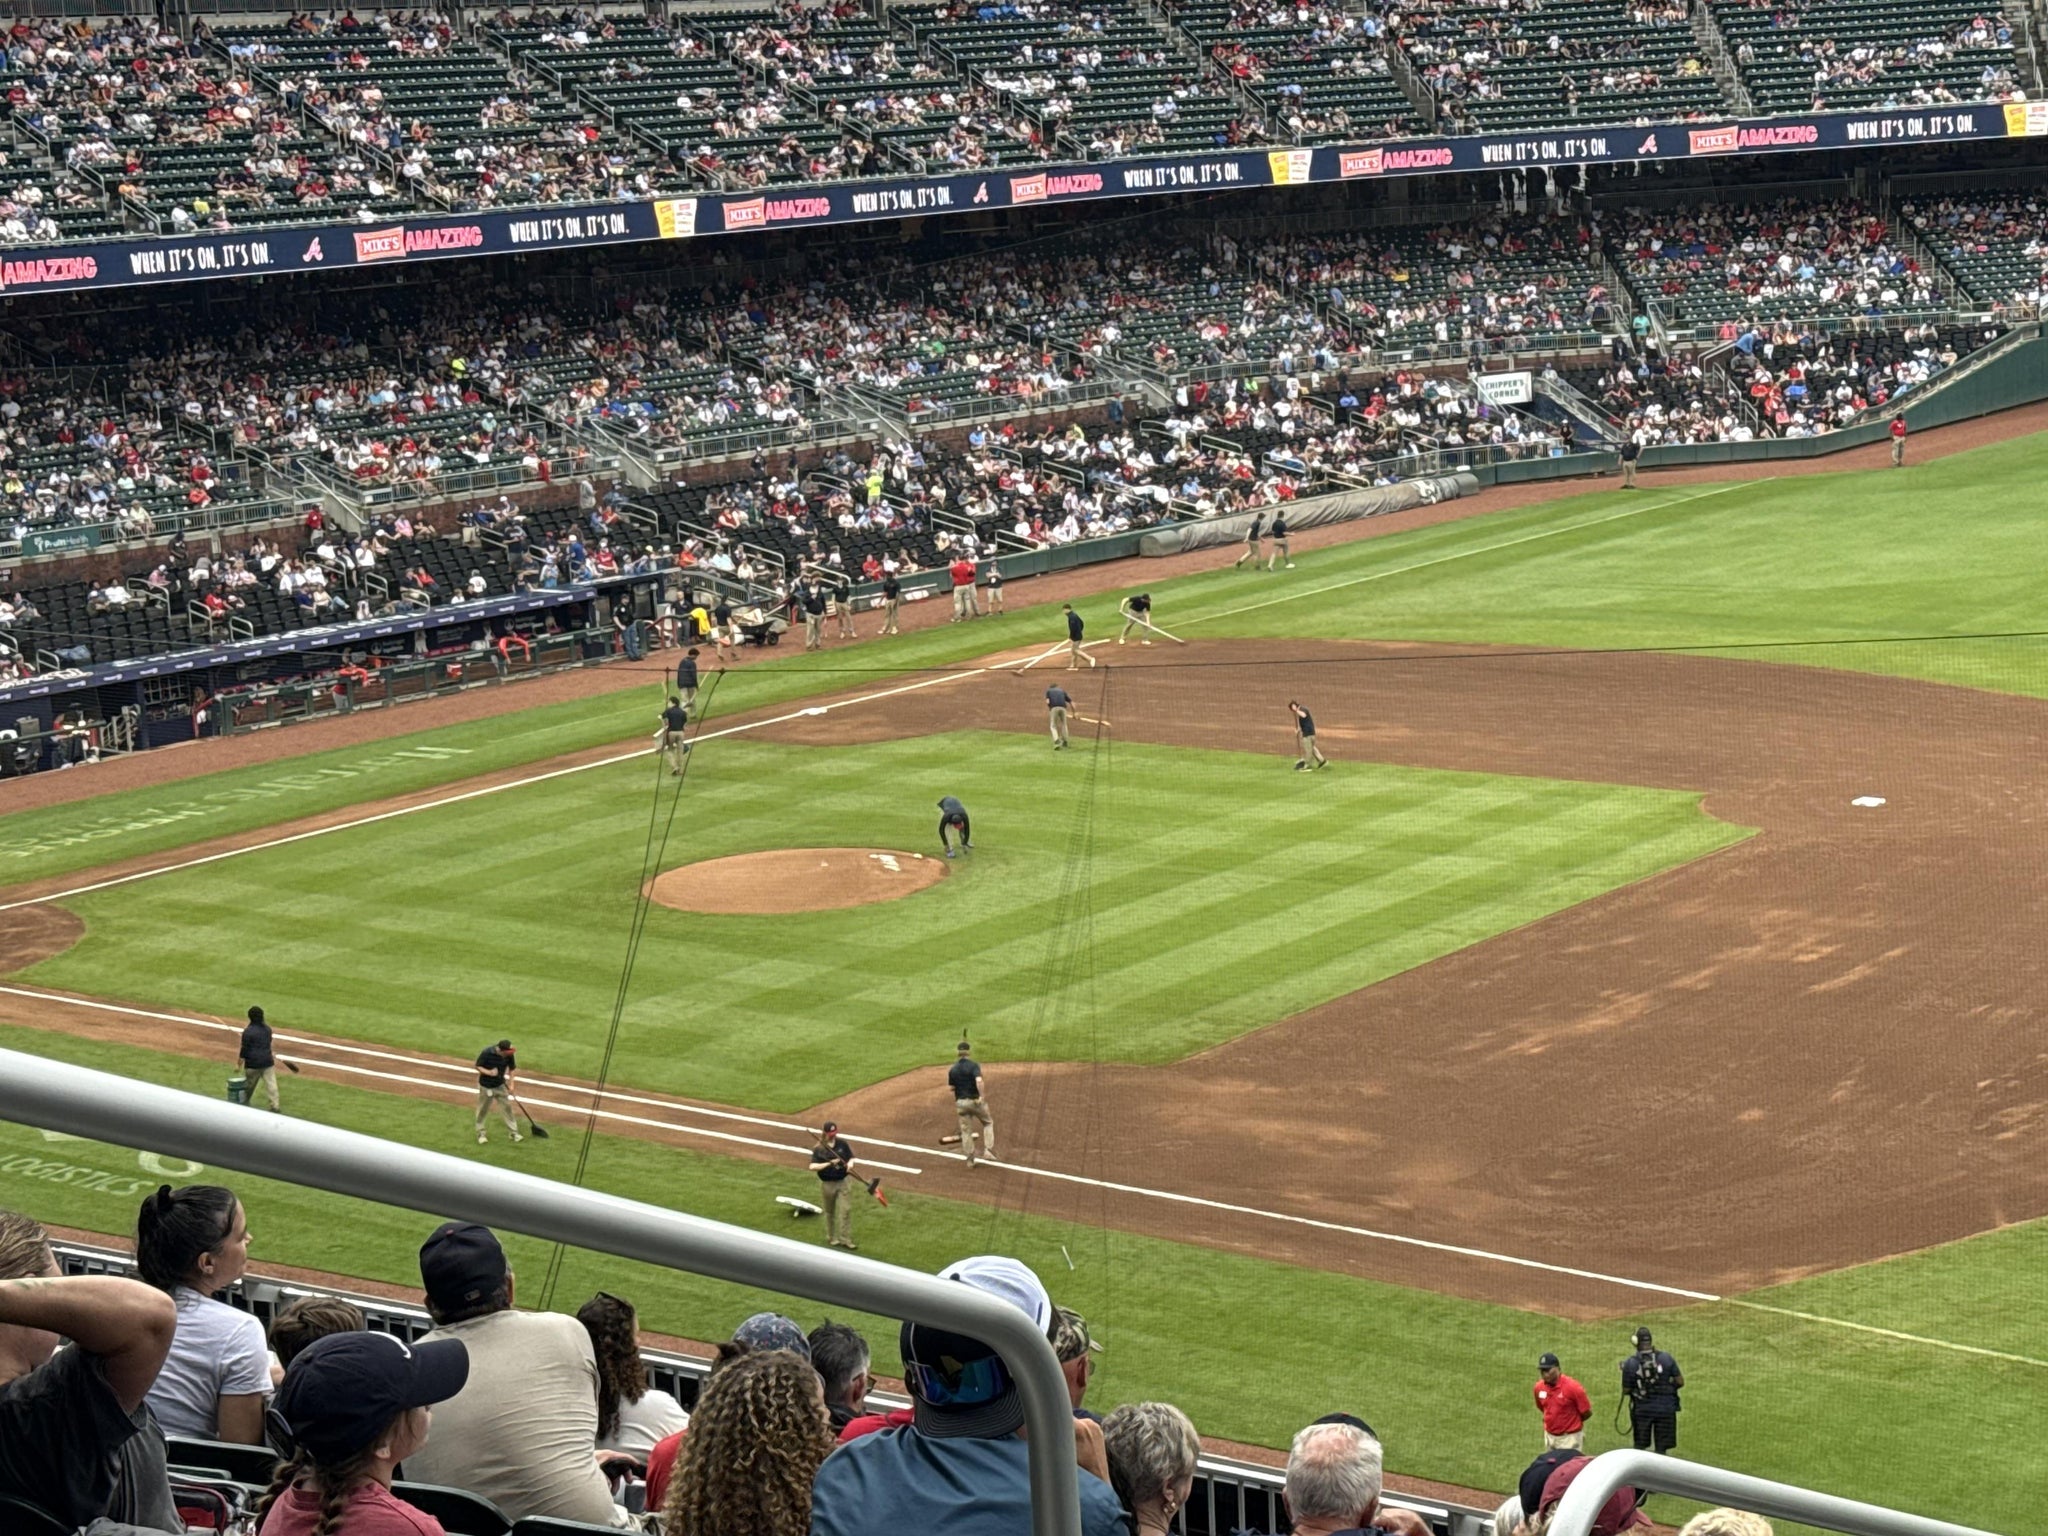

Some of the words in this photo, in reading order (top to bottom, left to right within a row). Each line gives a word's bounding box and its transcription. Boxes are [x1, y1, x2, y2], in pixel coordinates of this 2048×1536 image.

[1696, 133, 1733, 149] MIKE'S
[1738, 125, 1819, 146] AMAZING
[1847, 120, 1879, 141] WHEN
[1881, 119, 1905, 139] IT'S
[1907, 117, 1928, 137] ON,
[1930, 115, 1955, 136] IT'S
[1957, 114, 1978, 134] ON.
[1345, 155, 1379, 171] MIKE'S
[1383, 148, 1453, 169] AMAZING
[1482, 144, 1513, 163] WHEN
[1515, 142, 1539, 161] IT'S
[1541, 140, 1562, 159] ON,
[1564, 139, 1589, 158] IT'S
[1591, 138, 1612, 157] ON.
[1015, 179, 1044, 197] MIKE'S
[1046, 173, 1103, 195] AMAZING
[1124, 168, 1153, 188] WHEN
[1154, 167, 1178, 187] IT'S
[1179, 165, 1199, 184] ON,
[1200, 163, 1223, 183] IT'S
[1224, 162, 1243, 181] ON.
[729, 205, 761, 223] MIKE'S
[765, 197, 831, 220] AMAZING
[853, 192, 879, 214] WHEN
[879, 190, 899, 212] IT'S
[899, 189, 917, 210] ON,
[917, 187, 936, 208] IT'S
[937, 186, 954, 206] ON.
[361, 234, 400, 255] MIKE'S
[404, 226, 483, 251] AMAZING
[509, 220, 540, 244] WHEN
[541, 218, 565, 241] IT'S
[565, 216, 586, 239] ON,
[587, 214, 609, 237] IT'S
[610, 213, 630, 235] ON.
[3, 256, 97, 285] AMAZING
[130, 250, 165, 275] WHEN
[168, 247, 195, 272] IT'S
[197, 246, 221, 270] ON,
[222, 243, 249, 267] IT'S
[251, 242, 274, 265] ON.
[1485, 379, 1524, 391] CHIPPER'S
[1489, 389, 1520, 399] CORNER
